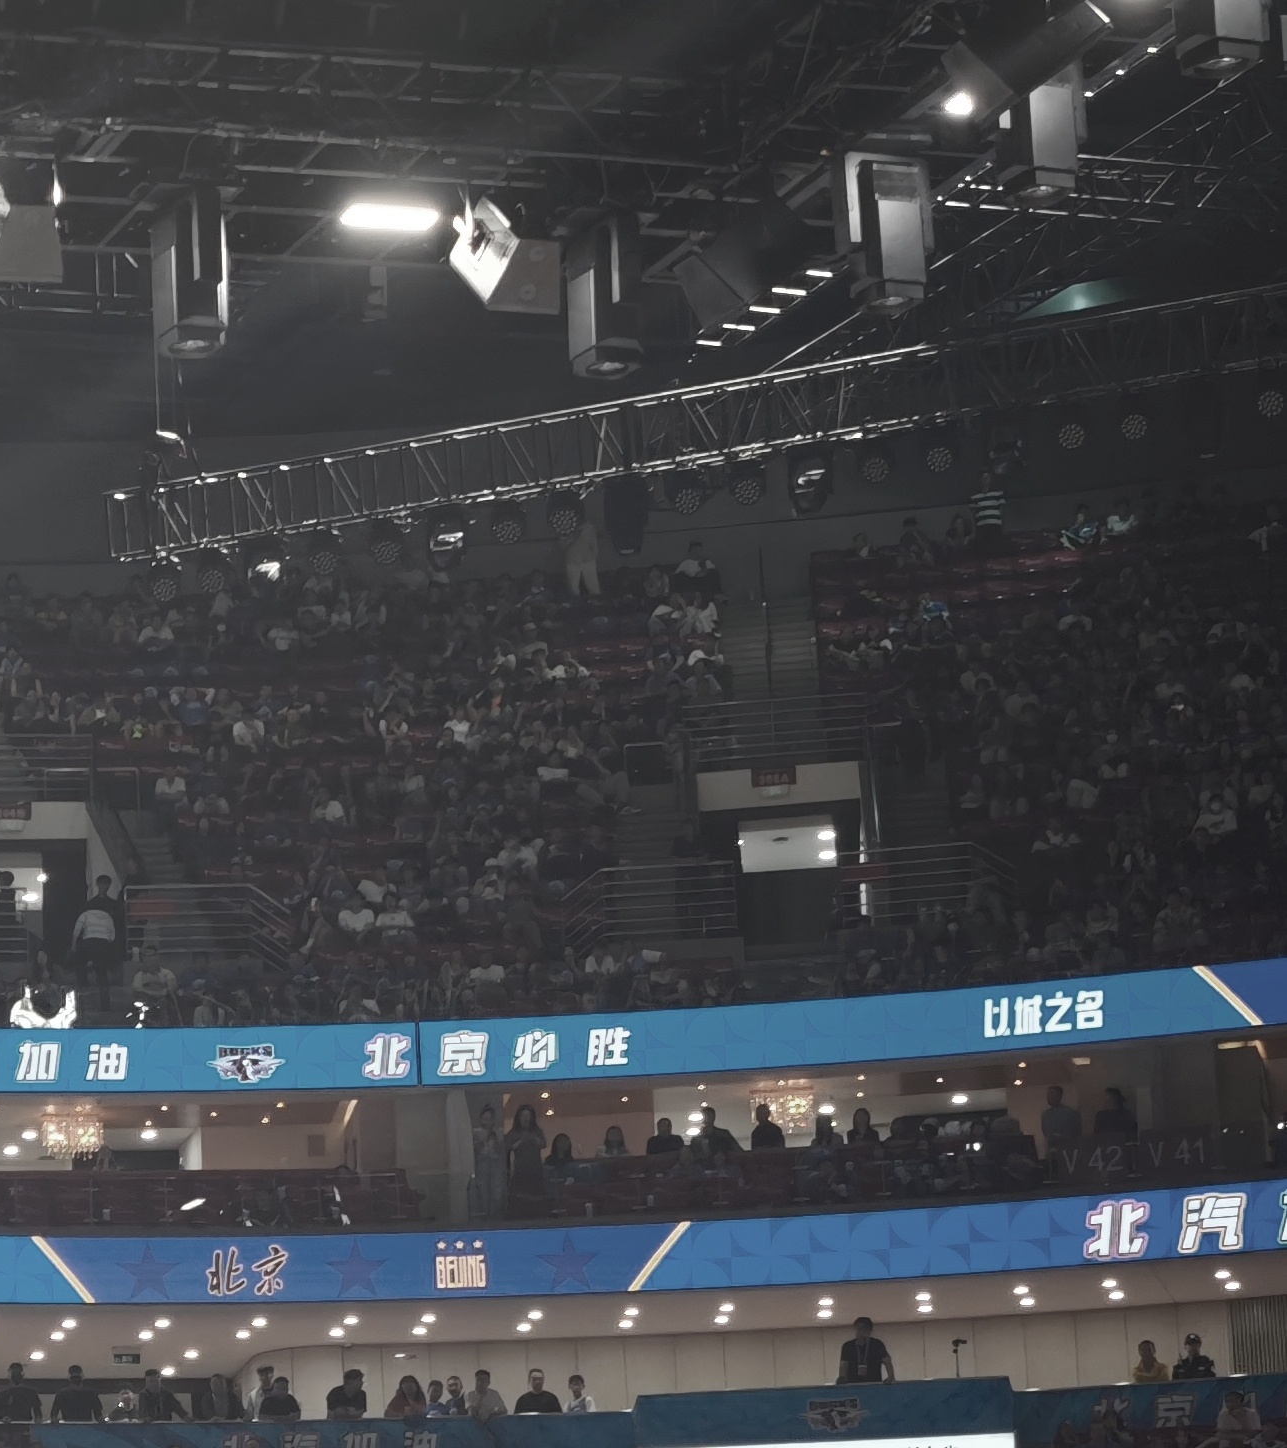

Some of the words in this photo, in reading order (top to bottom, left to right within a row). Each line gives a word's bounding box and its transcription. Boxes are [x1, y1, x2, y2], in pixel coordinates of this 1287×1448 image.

[983, 990, 1104, 1038] 以城之名
[363, 1027, 632, 1080] 北京必胜
[1063, 1149, 1077, 1174] V
[1088, 1146, 1122, 1172] 42
[1149, 1142, 1164, 1168] V
[1174, 1140, 1205, 1165] 41
[1083, 1192, 1287, 1261] 北汽
[206, 1246, 289, 1297] 北京
